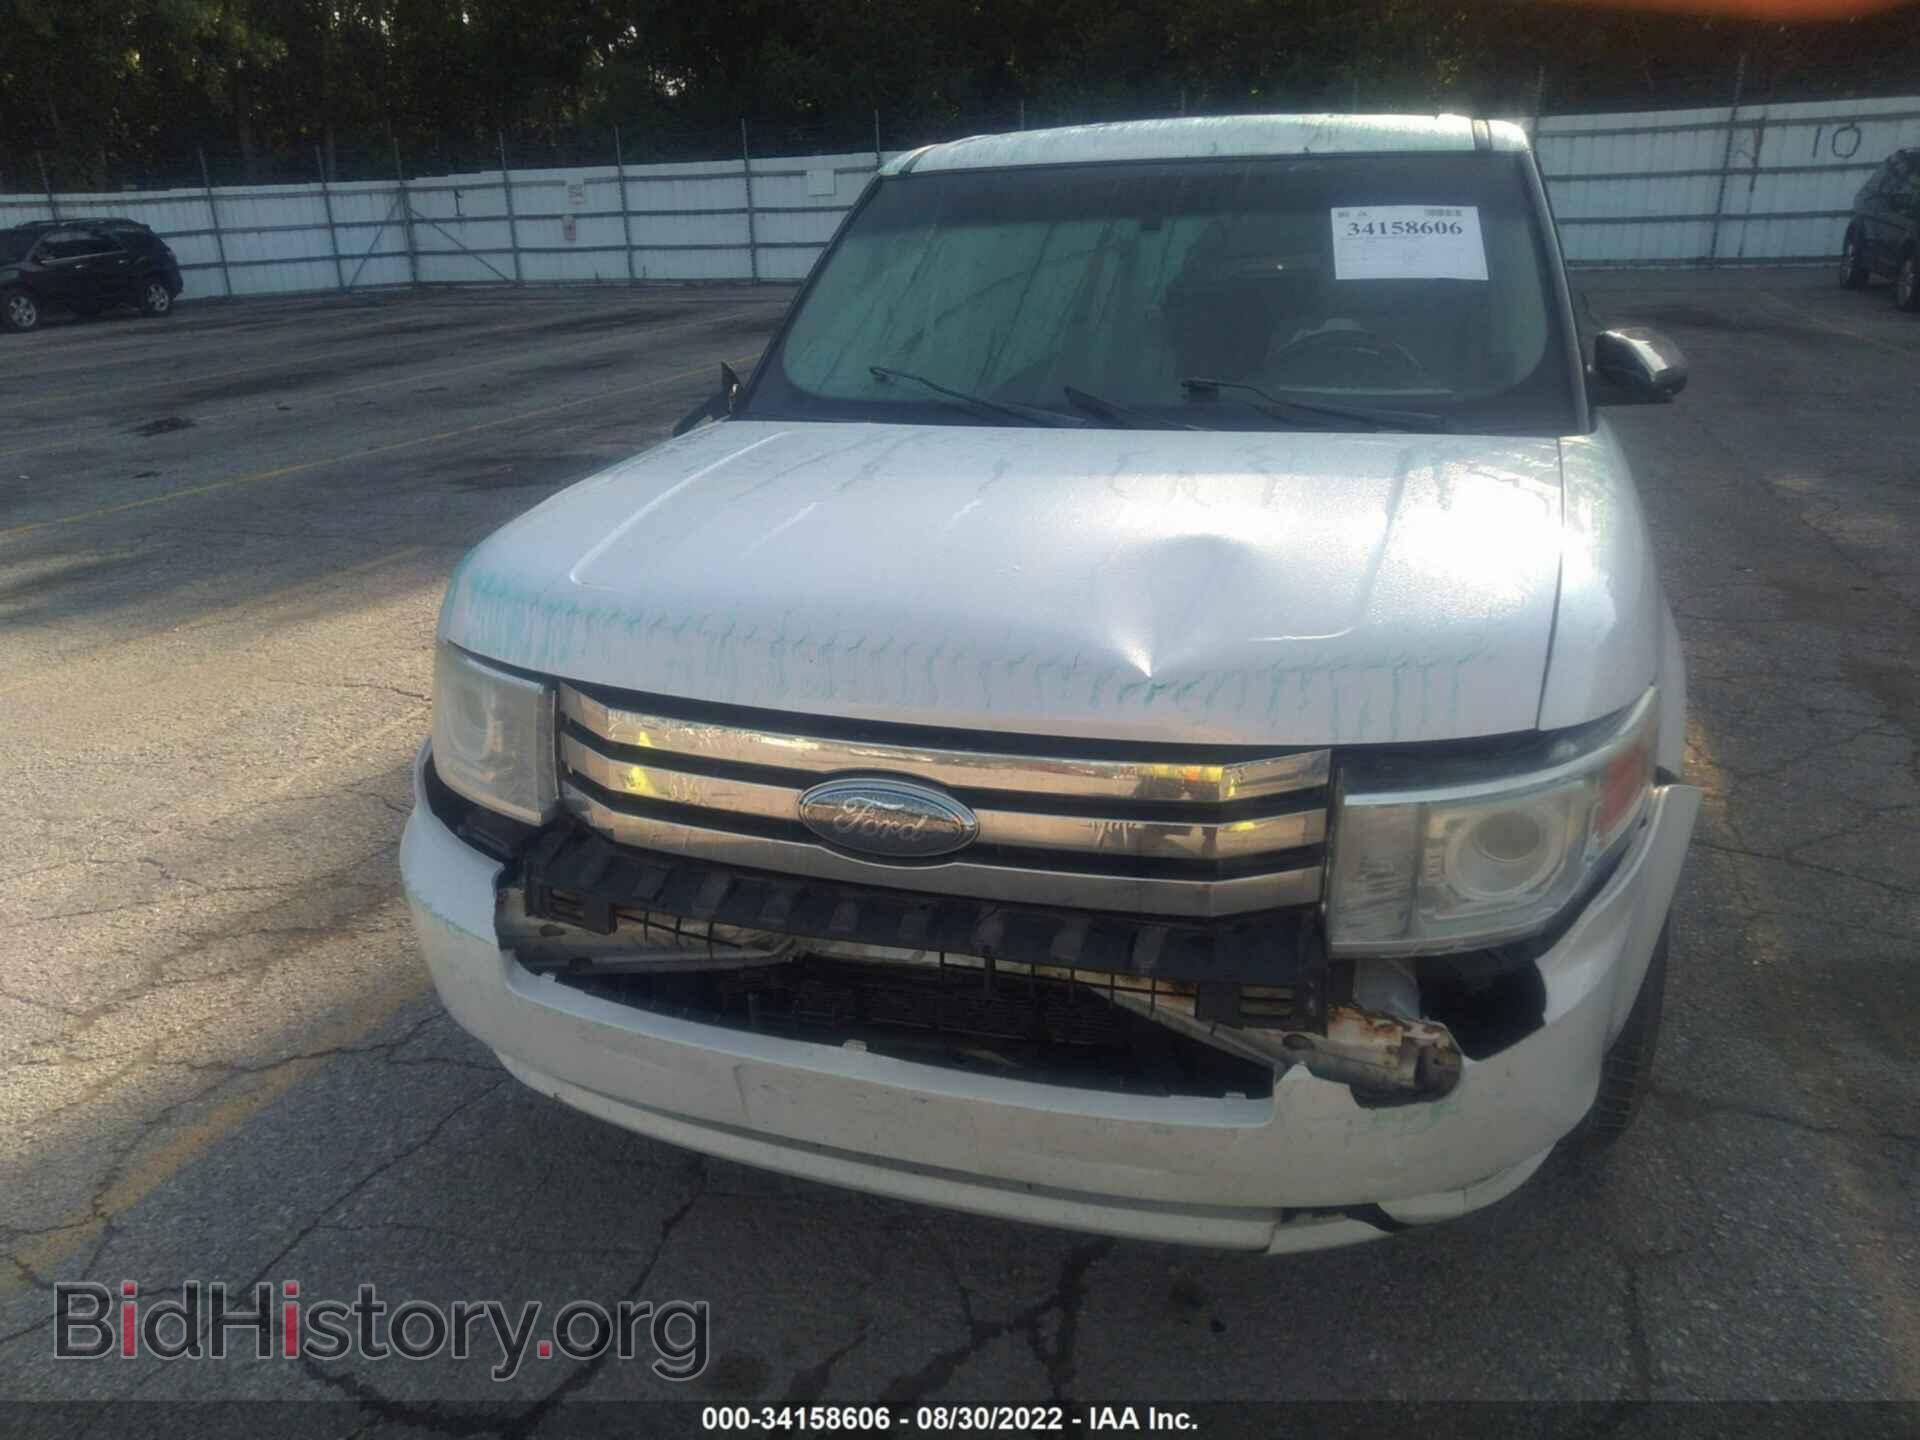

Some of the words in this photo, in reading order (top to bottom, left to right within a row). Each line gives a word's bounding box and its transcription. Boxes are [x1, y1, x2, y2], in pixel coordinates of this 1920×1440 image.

[1812, 122, 1861, 159] 10
[1347, 220, 1463, 236] 34158606
[833, 797, 925, 841] Ford
